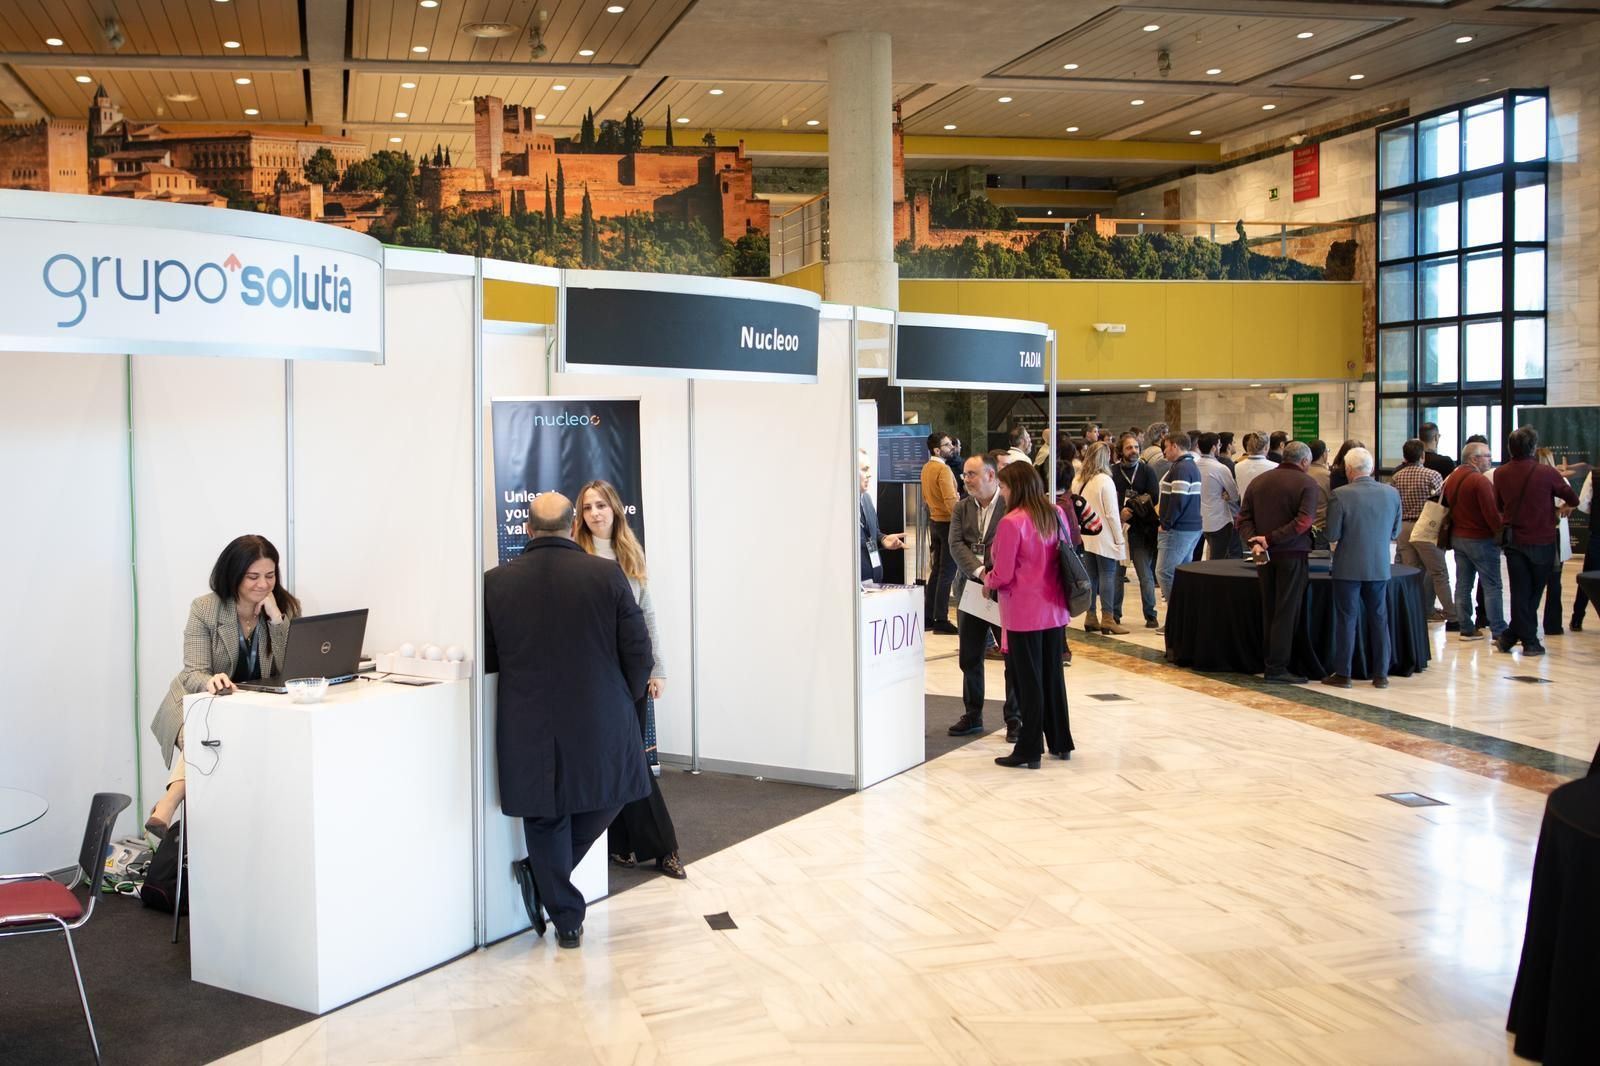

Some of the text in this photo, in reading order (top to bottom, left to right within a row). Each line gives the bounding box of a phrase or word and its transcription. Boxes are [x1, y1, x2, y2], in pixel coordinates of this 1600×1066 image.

[43, 253, 352, 328] grupo solutia
[740, 326, 799, 351] Nucleoo
[1019, 351, 1042, 368] TADIA
[504, 489, 556, 503] Unle
[506, 522, 529, 535] val
[868, 611, 923, 656] TADIA
